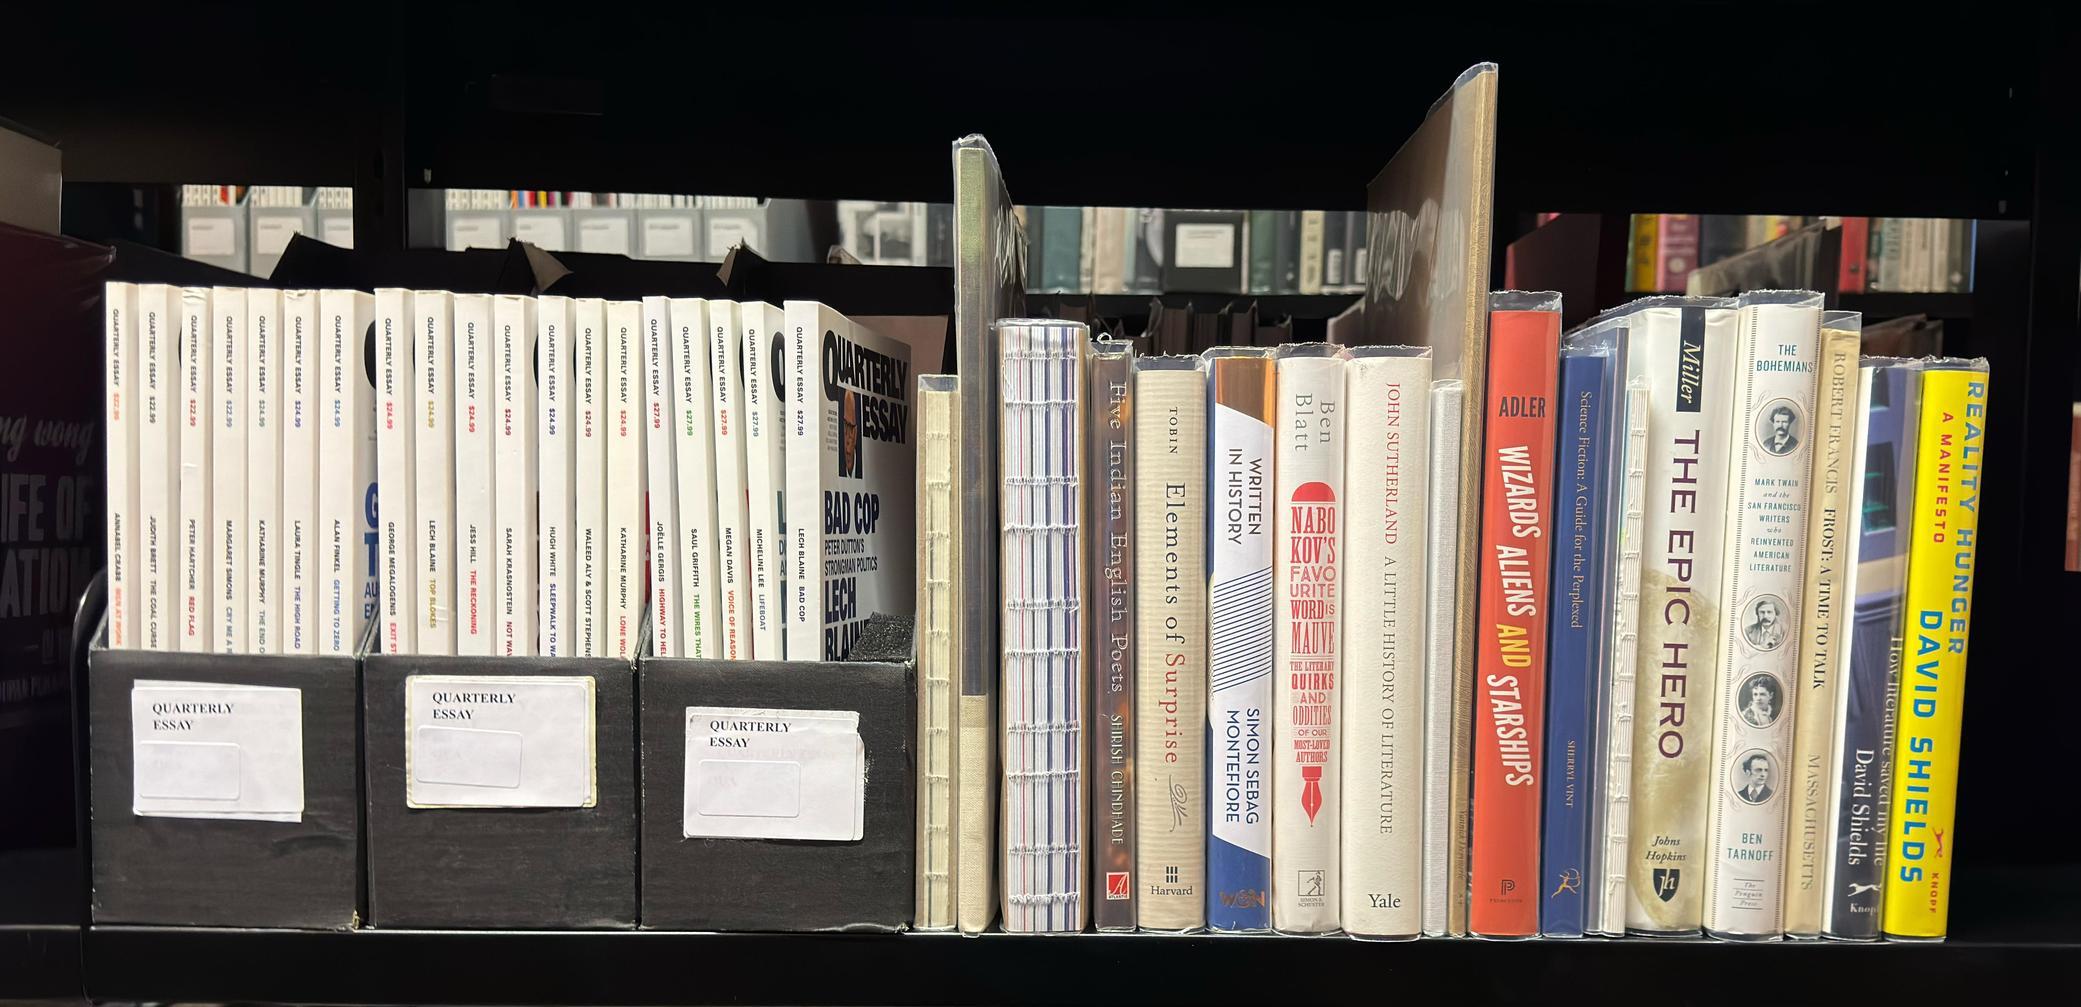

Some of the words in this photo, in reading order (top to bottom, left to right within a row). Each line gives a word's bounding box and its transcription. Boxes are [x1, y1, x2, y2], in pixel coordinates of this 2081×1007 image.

[148, 312, 156, 361] QUARTERLY
[467, 322, 475, 370] QUARTERLY
[796, 327, 804, 374] QUARTERLY
[1778, 345, 1797, 356] THE
[148, 362, 156, 389] ESSAY
[822, 329, 908, 401] QUARTERLY
[1681, 339, 1701, 403] Miller
[1756, 360, 1813, 372] BOHEMIANS
[796, 377, 804, 403] ESSAY
[1832, 352, 1846, 419] ROBERT
[468, 405, 476, 432] $24.99
[862, 394, 908, 444] ESSAY
[1110, 381, 1126, 429] Five
[1386, 384, 1400, 426] JOHN
[1499, 397, 1545, 417] ADLER
[1580, 391, 1592, 433] Science
[1942, 412, 1954, 422] A
[1169, 407, 1178, 454] TOBIN
[1295, 394, 1312, 450] Blatt
[1320, 400, 1335, 444] Ben
[1228, 449, 1242, 466] IN
[1577, 437, 1590, 480] Fiction:
[1826, 424, 1841, 494] FRANCIS
[1959, 382, 1985, 512] REALITY
[1110, 440, 1126, 520] Indian
[1670, 430, 1700, 513] THE
[1248, 458, 1262, 534] WRITTEN
[1385, 432, 1400, 544] SUTHERLAND
[1498, 446, 1542, 538] WIZARDS
[1576, 484, 1586, 492] A
[1934, 434, 1953, 543] MANIFESTO
[825, 491, 851, 534] BAD
[855, 492, 879, 534] COP
[1228, 471, 1242, 544] HISTORY
[1291, 507, 1335, 534] NABO
[1575, 496, 1586, 530] Guide
[1764, 503, 1800, 511] FRANCISCO
[188, 519, 196, 544] PETER
[333, 519, 341, 542] ALAN
[469, 524, 477, 544] JESS
[549, 527, 557, 549] HUGH
[725, 528, 733, 557] MEGAN
[1166, 482, 1186, 604] Elements
[1574, 534, 1586, 550] for
[1751, 538, 1793, 546] REINVENTED
[1821, 508, 1836, 562] FROST:
[333, 545, 341, 573] FINKEL
[469, 546, 477, 563] HILL
[825, 540, 839, 555] PETER
[841, 539, 864, 552] DUTTON'S
[1291, 537, 1335, 563] KOV'S
[1384, 556, 1396, 566] A
[549, 552, 557, 576] WHITE
[726, 560, 734, 583] DAVIS
[825, 559, 855, 576] STRONGMAN
[857, 557, 878, 571] POLITICS
[1291, 566, 1336, 582] FAVO
[1573, 553, 1585, 571] the
[1750, 564, 1791, 572] LITERATURE
[1820, 565, 1832, 574] A
[469, 570, 477, 586] THE
[1105, 532, 1128, 622] English
[1290, 584, 1335, 598] URITE
[1496, 544, 1536, 616] ALIENS
[1665, 530, 1694, 625] EPIC
[188, 596, 196, 613] RED
[333, 579, 341, 615] GETTING
[727, 590, 735, 614] VOICE
[798, 586, 806, 603] BAD
[825, 577, 856, 624] LECH
[1384, 572, 1396, 628] LITTLE
[1569, 574, 1584, 628] Perplexed
[1817, 579, 1830, 618] TIME
[1948, 529, 1974, 654] HUNGER
[470, 587, 478, 634] RECKONING
[549, 584, 557, 630] SLEEPWALK
[798, 605, 806, 622] COP
[1291, 600, 1324, 619] WORD
[1326, 604, 1335, 614] IS
[333, 617, 341, 628] TO
[728, 616, 736, 627] OF
[1166, 616, 1185, 644] of
[1816, 622, 1828, 645] TO
[333, 630, 341, 651] ZERO
[549, 632, 557, 643] TO
[728, 629, 736, 660] REASON
[1291, 622, 1334, 654] MAUVE
[1496, 624, 1532, 667] AND
[1111, 634, 1127, 692] Poets
[1290, 662, 1302, 671] THE
[1382, 632, 1396, 702] HISTORY
[1813, 649, 1827, 689] TALK
[1888, 636, 1904, 674] How
[1913, 610, 1943, 718] DAVID
[1292, 673, 1334, 690] QUIRKS
[152, 702, 235, 715] QUARTERLY
[432, 692, 515, 705] QUARTERLY
[1159, 653, 1185, 763] Surprise
[1300, 692, 1326, 703] AND
[1658, 643, 1689, 759] HERO
[153, 720, 193, 731] ESSAY
[433, 709, 474, 720] ESSAY
[709, 721, 792, 734] QUARTERLY
[1293, 706, 1332, 725] ODDITIES
[1382, 708, 1394, 729] OF
[1882, 682, 1900, 756] literature
[709, 737, 750, 748] ESSAY
[1111, 714, 1124, 764] SHIRISH
[1246, 708, 1260, 764] SIMON
[1486, 674, 1534, 786] STARSHIPS
[1294, 740, 1330, 749] MOST-LOVED
[1296, 752, 1328, 762] AUTHORS
[1226, 710, 1240, 822] MONTEFIORE
[1567, 740, 1576, 781] SHERRYL
[1852, 748, 1874, 798] David
[1246, 770, 1260, 824] SEBAG
[1380, 734, 1394, 834] LITERATURE
[1566, 784, 1575, 808] VINT
[1878, 761, 1892, 806] saved
[1112, 771, 1124, 844] CHINDHADE
[1900, 737, 1933, 882] SHIELDS
[1801, 754, 1820, 890] MASSACHUSETTS
[1848, 804, 1870, 864] Shields
[1874, 811, 1888, 834] my
[1652, 836, 1680, 847] Johns
[1742, 833, 1762, 844] BEN
[1645, 851, 1686, 864] Hopkins
[1728, 848, 1773, 860] TARNOFF
[1151, 886, 1193, 895] Harvard
[1368, 894, 1400, 908] Yale
[1930, 872, 1939, 913] KNOPF
[1850, 903, 1878, 914] Knop
